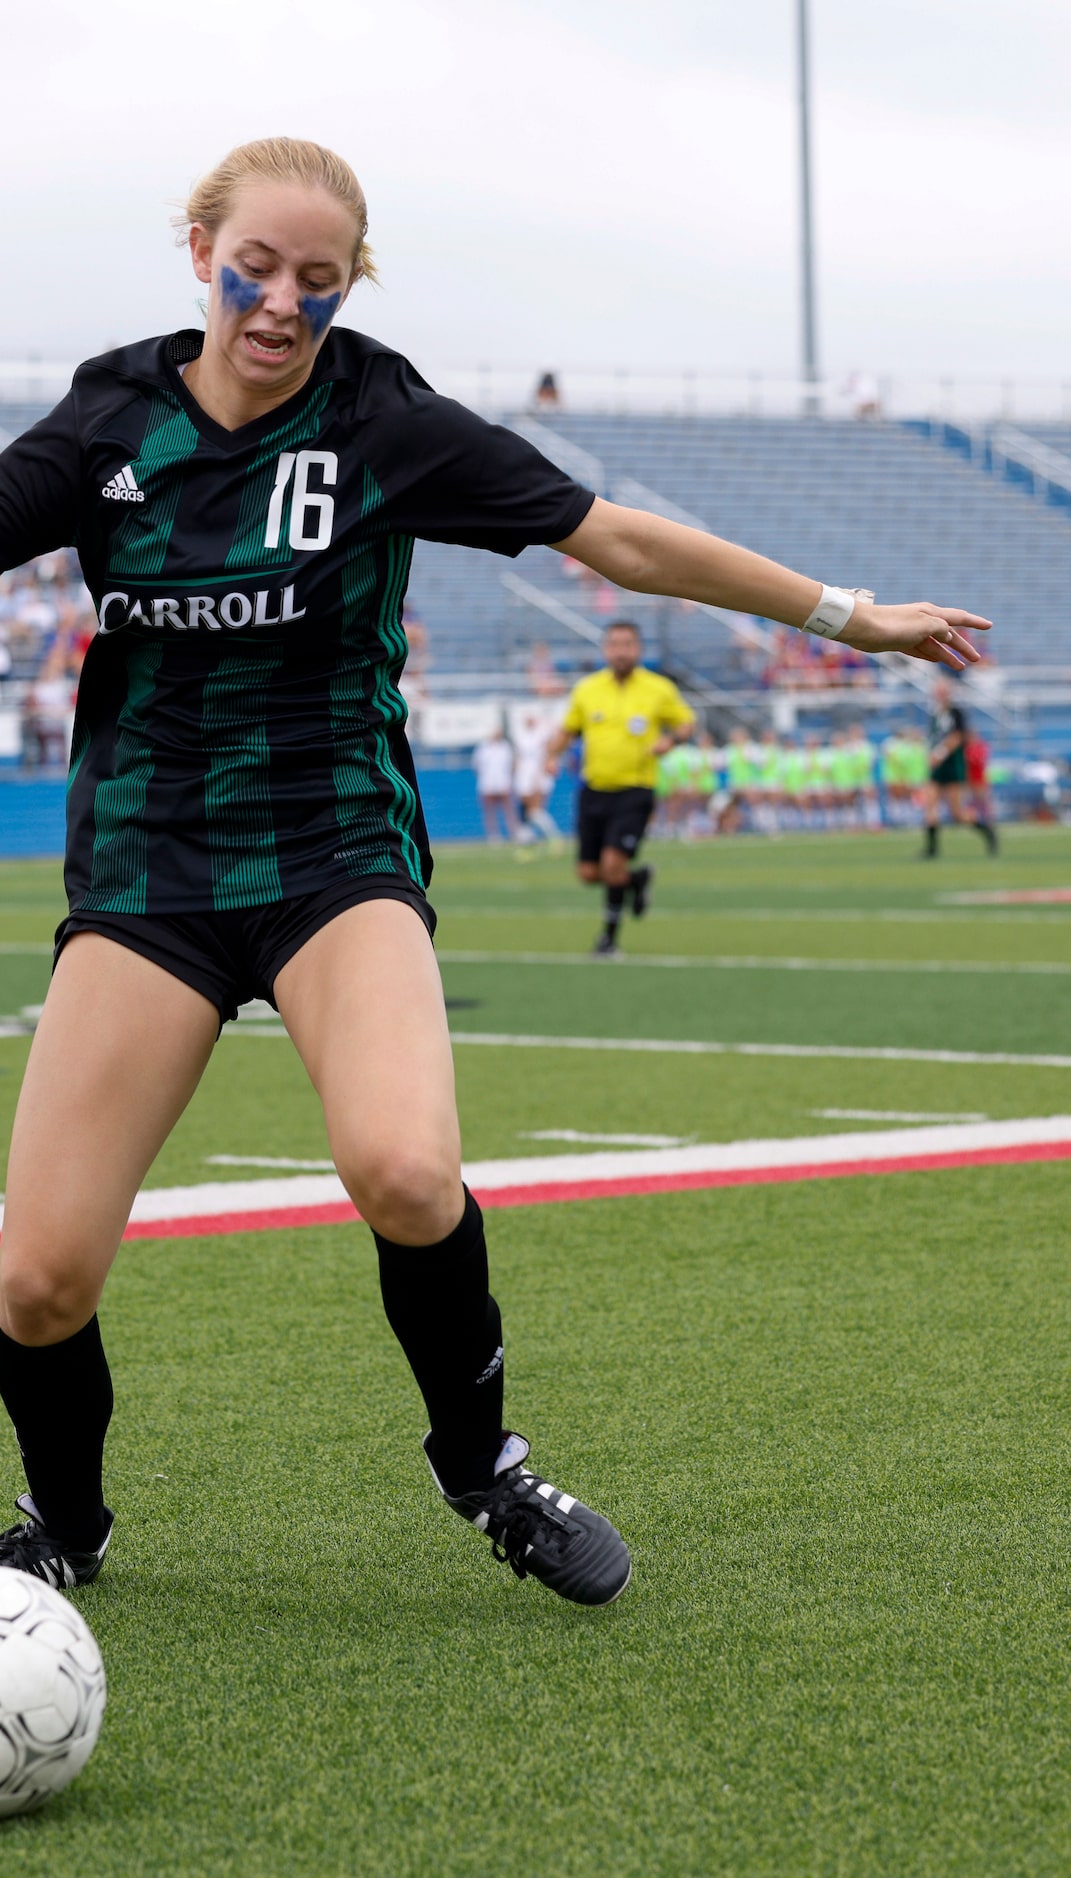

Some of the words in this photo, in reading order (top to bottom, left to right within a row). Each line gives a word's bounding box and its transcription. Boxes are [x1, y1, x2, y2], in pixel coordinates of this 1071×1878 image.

[102, 486, 145, 502] adidas
[264, 450, 338, 550] 16
[98, 584, 307, 634] CARROLL
